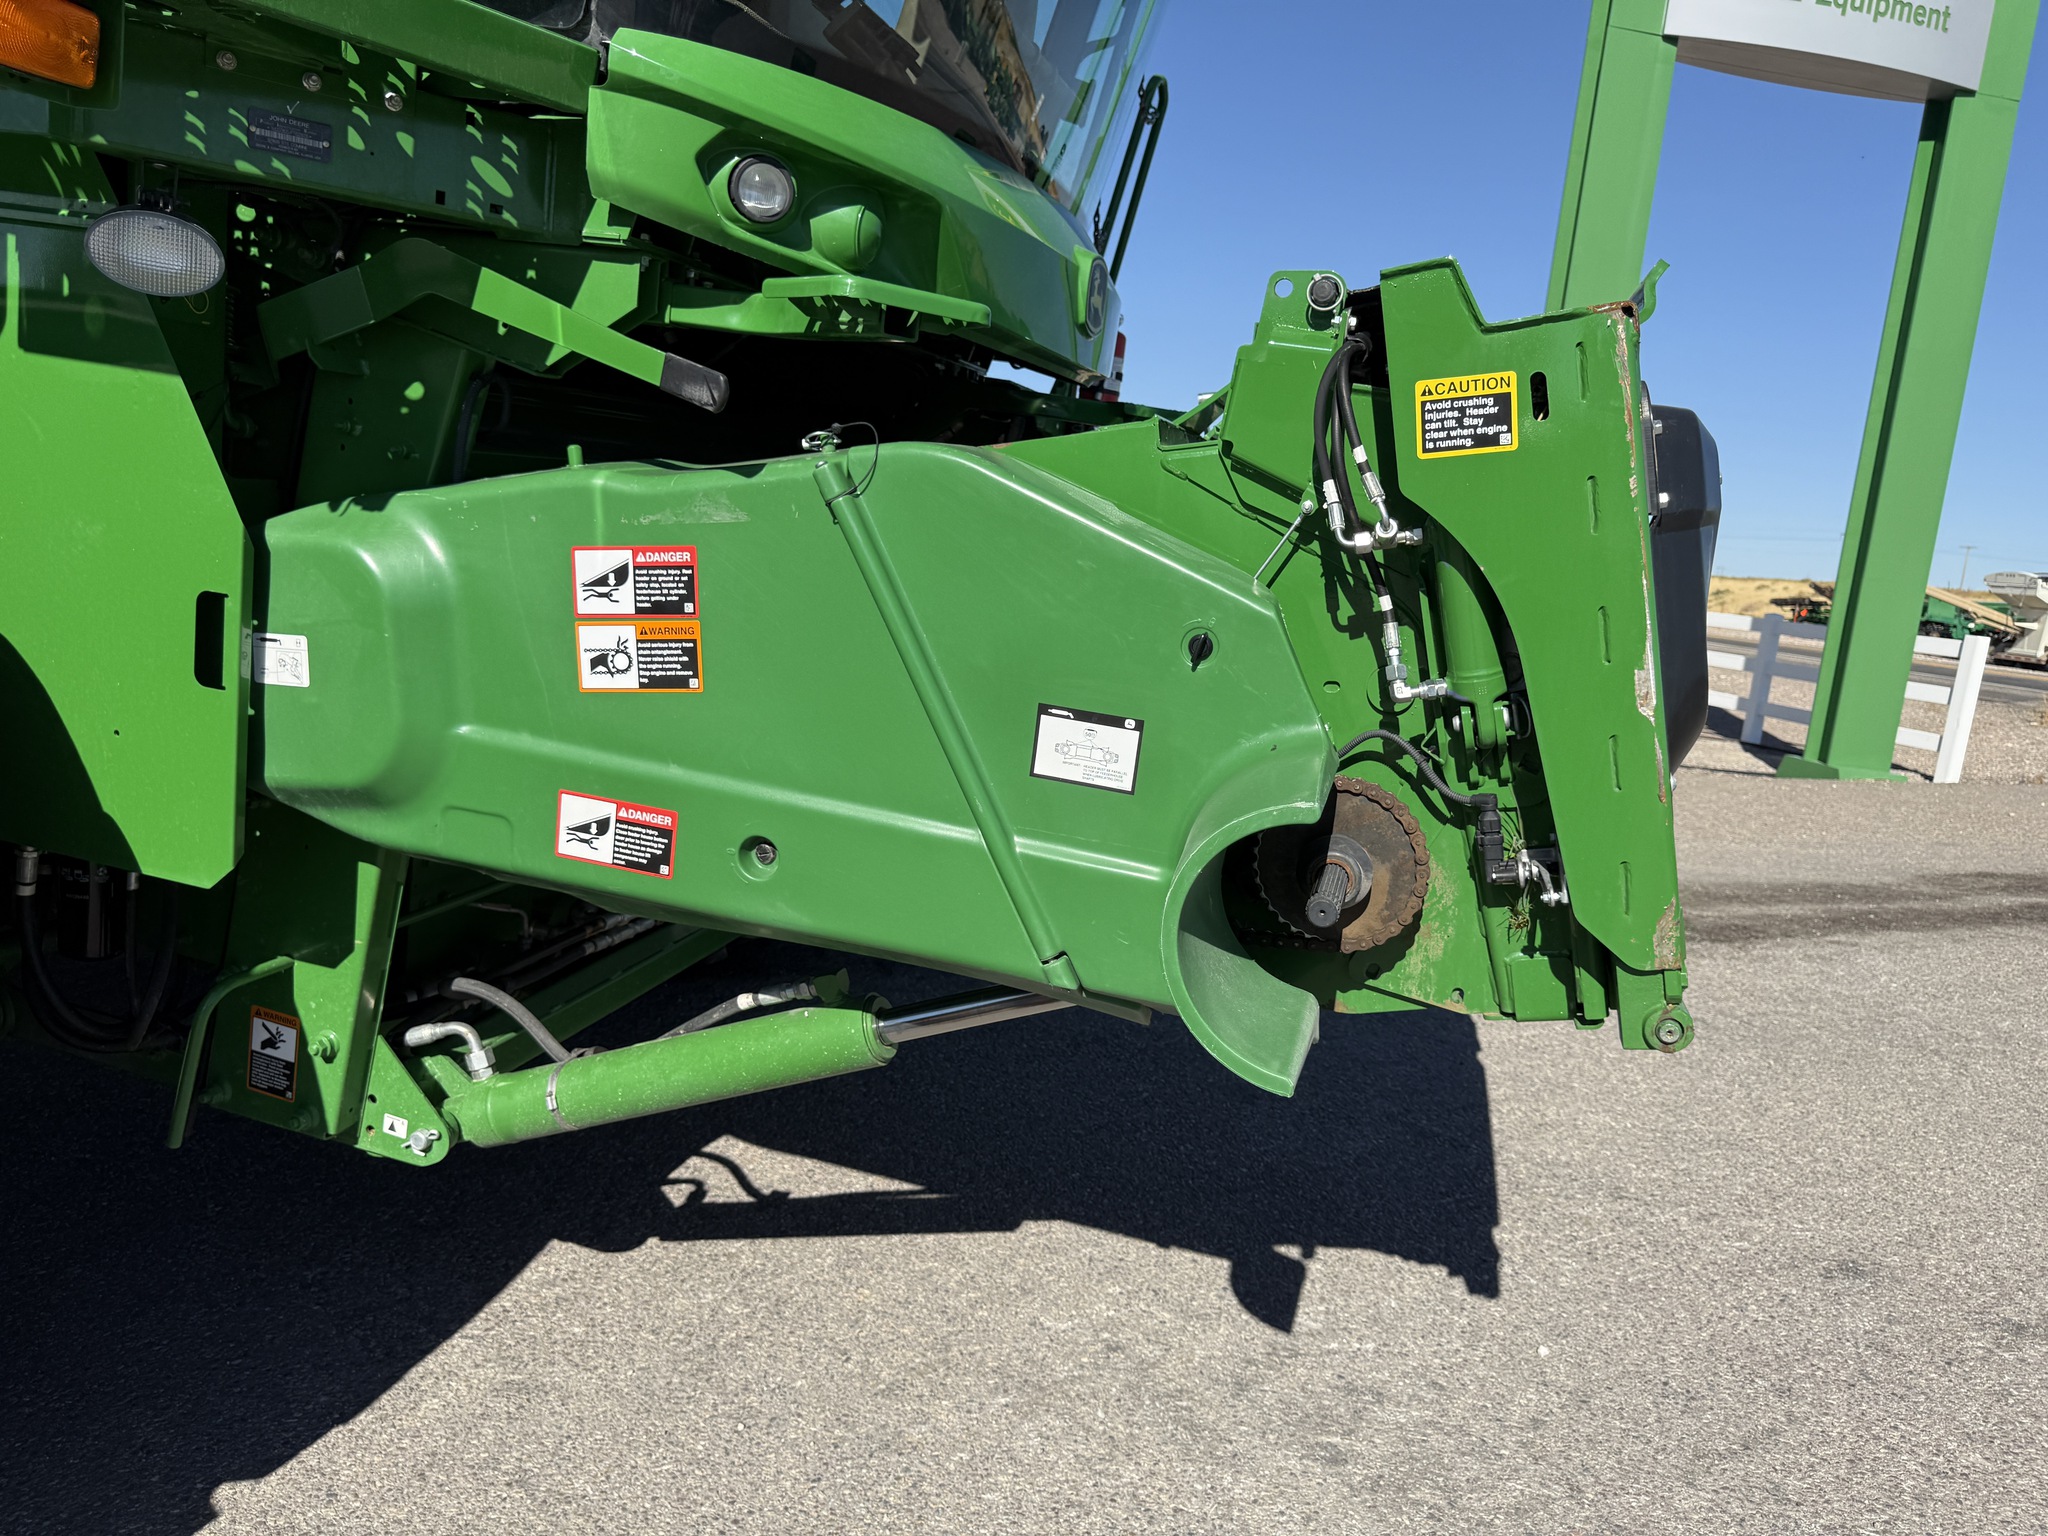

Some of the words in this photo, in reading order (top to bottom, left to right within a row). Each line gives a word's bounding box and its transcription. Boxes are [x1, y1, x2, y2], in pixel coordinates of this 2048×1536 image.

[1815, 0, 1951, 33] quipment
[269, 115, 287, 124] JOHN
[288, 118, 310, 129] DEERE
[1434, 376, 1510, 395] CAUTION
[1425, 400, 1451, 410] Avoid
[1453, 396, 1494, 407] crushing
[1425, 410, 1461, 421] injuries.
[1466, 406, 1499, 416] Header
[1425, 422, 1442, 430] can
[1444, 419, 1458, 428] tilt.
[1463, 417, 1484, 426] Stay
[1425, 430, 1448, 439] clear
[1450, 428, 1474, 437] when
[1476, 424, 1508, 435] engine
[1436, 438, 1474, 448] running.
[646, 552, 691, 562] DANGER
[649, 627, 695, 635] WARNING
[628, 810, 672, 826] DANGER
[263, 1010, 297, 1026] WARNING
